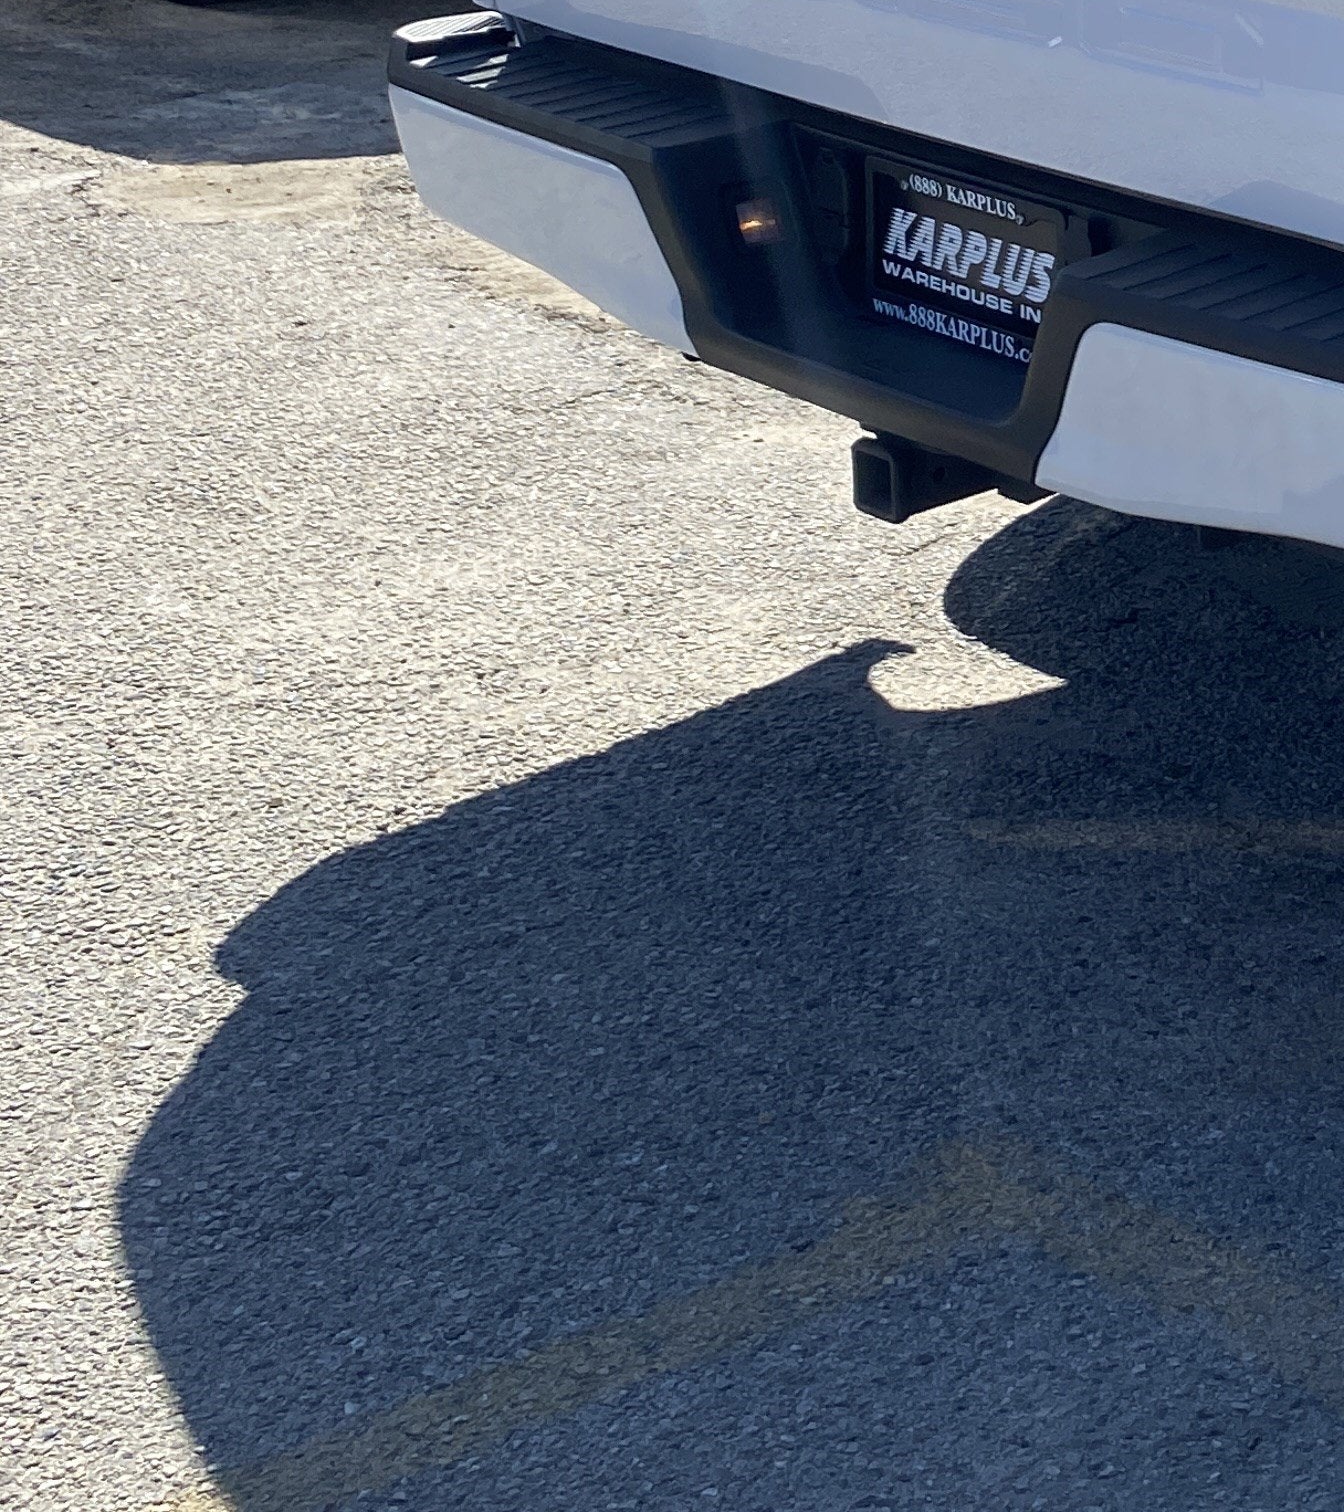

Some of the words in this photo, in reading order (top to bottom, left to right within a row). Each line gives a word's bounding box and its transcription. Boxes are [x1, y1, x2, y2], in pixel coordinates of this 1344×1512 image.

[909, 173, 943, 198] (888)
[946, 184, 1016, 220] KARPLUS
[883, 207, 1055, 303] KARPLUS
[882, 259, 1013, 315] WAREHOUSE
